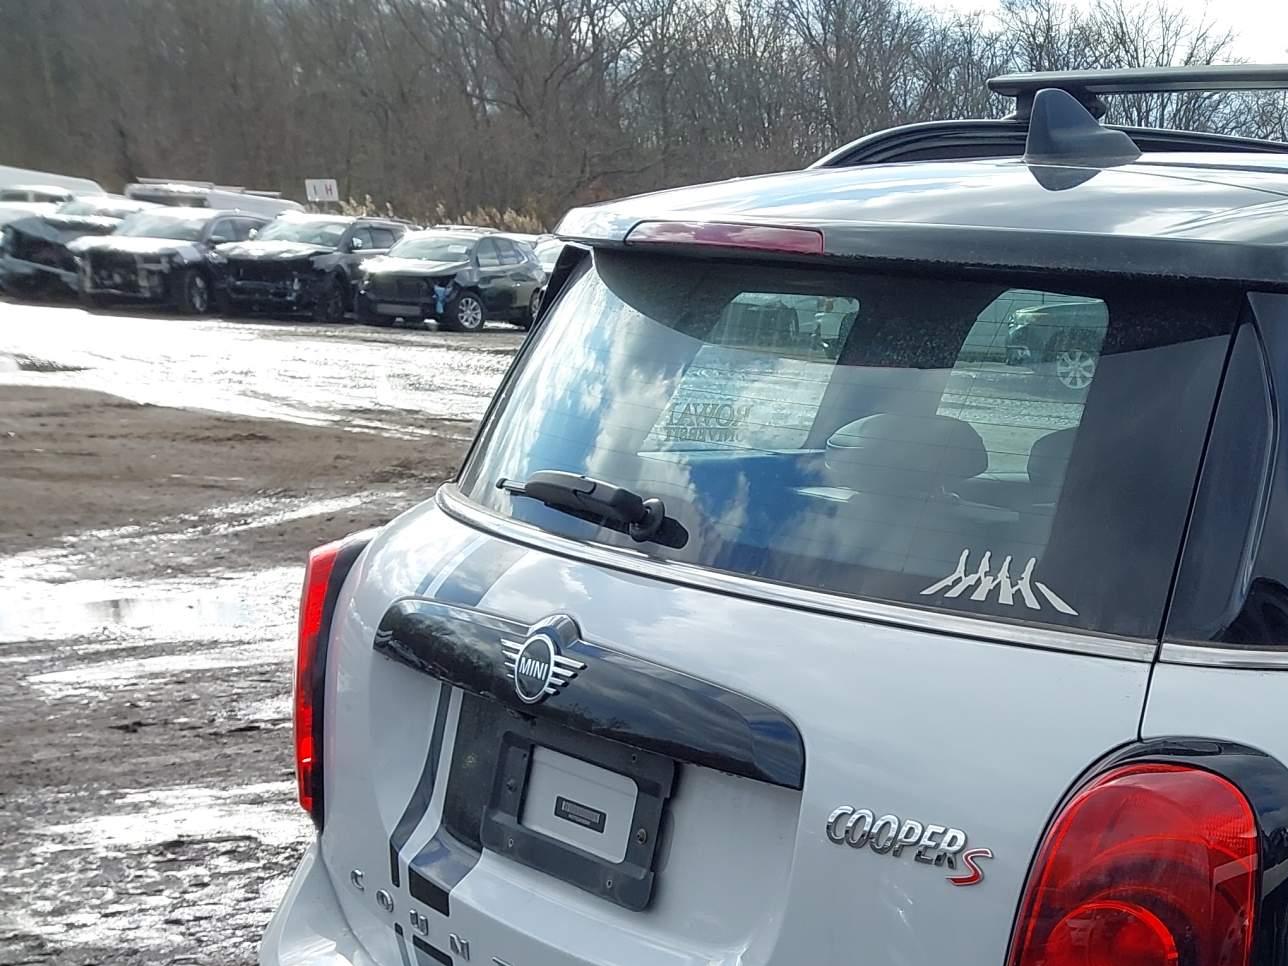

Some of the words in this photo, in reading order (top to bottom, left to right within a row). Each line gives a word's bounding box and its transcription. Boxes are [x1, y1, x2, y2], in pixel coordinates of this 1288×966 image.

[519, 656, 549, 681] MINI
[826, 805, 967, 870] COOPER
[944, 848, 994, 886] S
